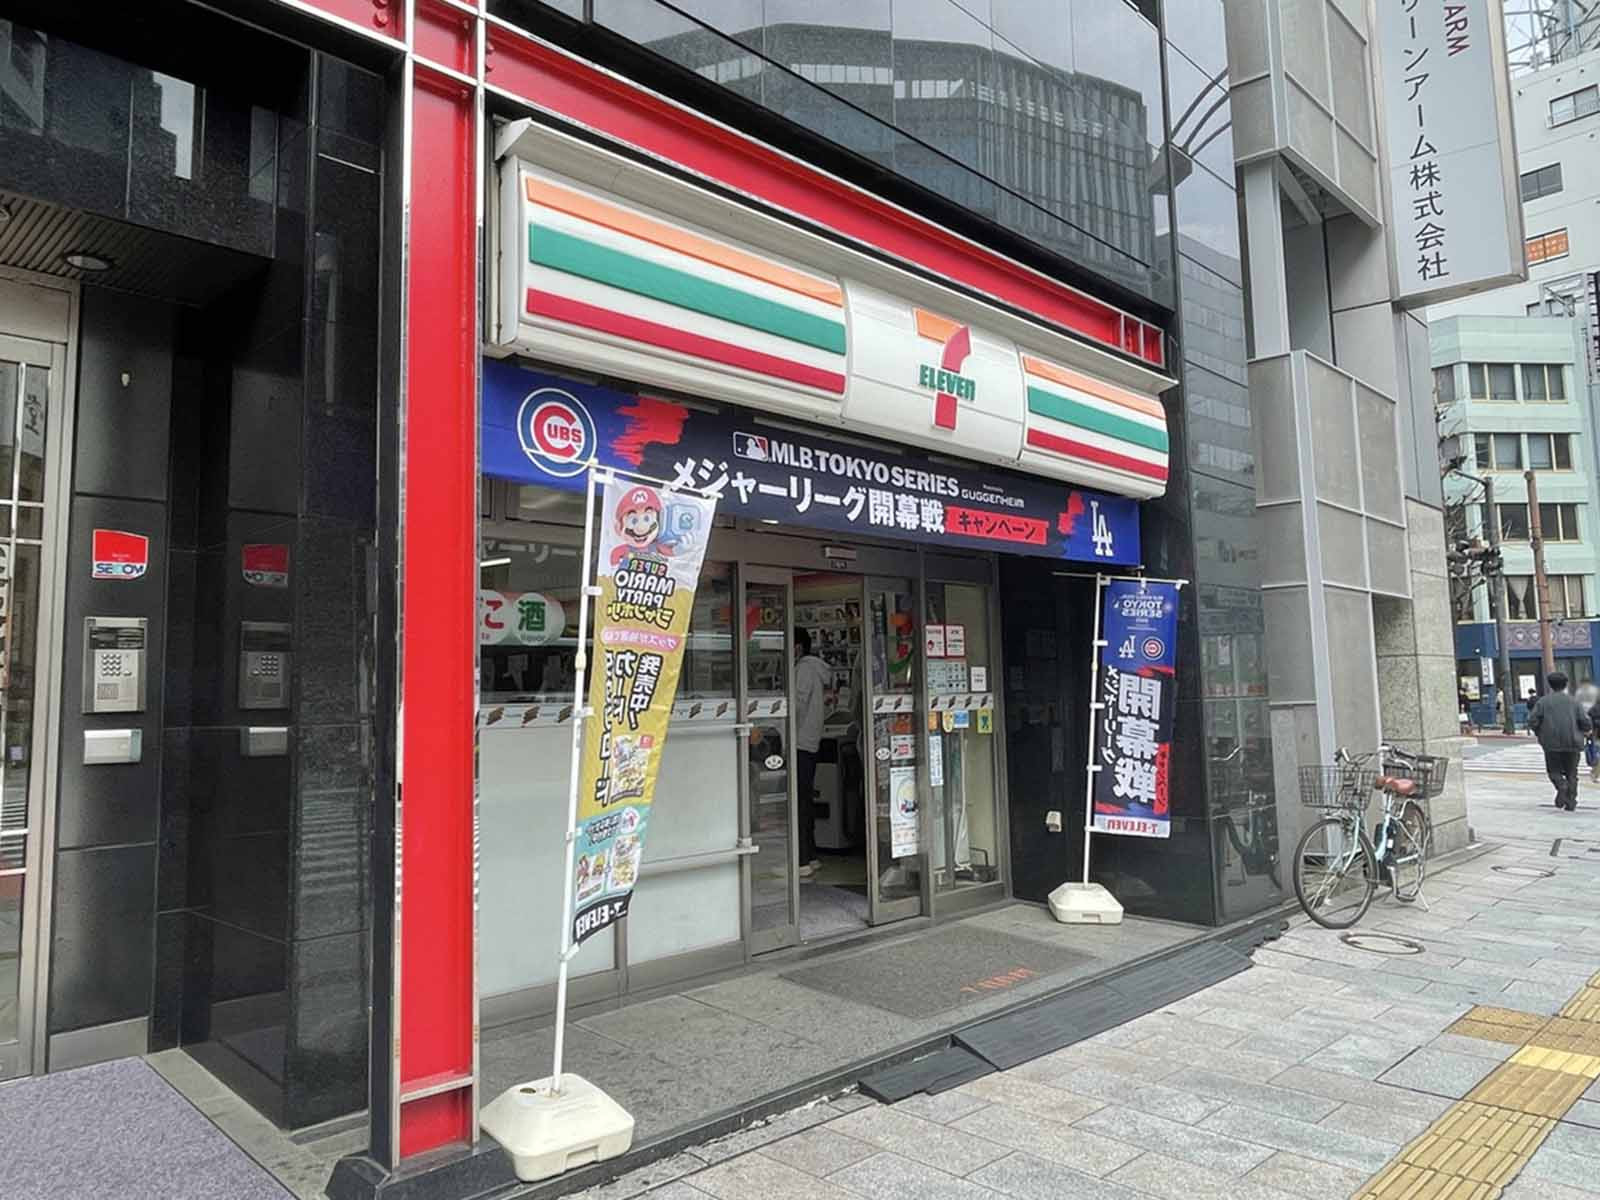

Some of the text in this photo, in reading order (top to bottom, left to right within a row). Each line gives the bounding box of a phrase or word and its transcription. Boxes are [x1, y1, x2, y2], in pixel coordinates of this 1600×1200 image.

[672, 457, 945, 534] メジャーリーグ開幕戦
[814, 450, 889, 483] TOKYO
[891, 466, 960, 497] SERIES
[958, 511, 1038, 541] キャンペーン
[1091, 500, 1113, 557] LA
[518, 600, 545, 631] 酒
